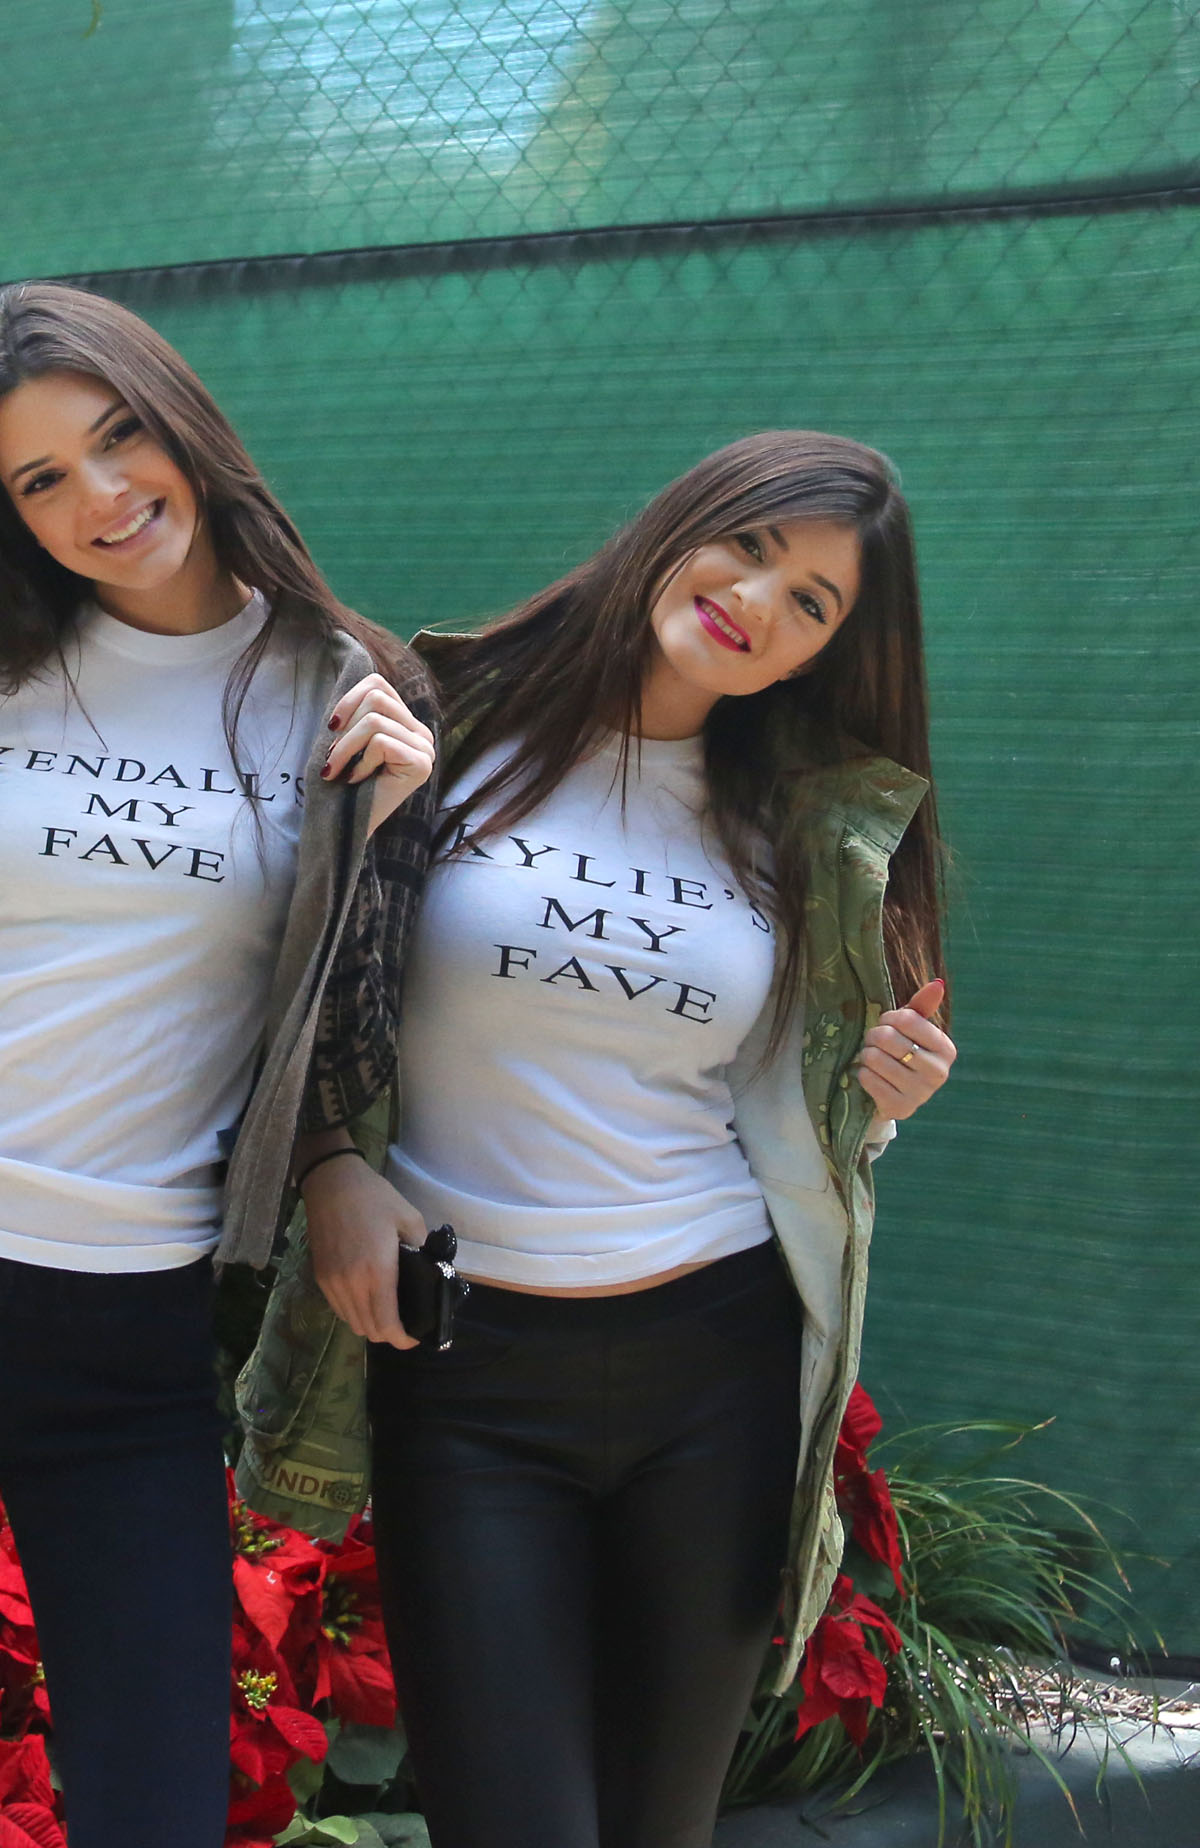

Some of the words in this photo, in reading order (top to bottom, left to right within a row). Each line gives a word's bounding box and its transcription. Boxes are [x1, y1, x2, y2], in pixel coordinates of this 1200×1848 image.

[80, 793, 197, 827] MY
[38, 827, 226, 883] FAVE
[535, 896, 687, 954] MY
[490, 944, 717, 1024] FAVE
